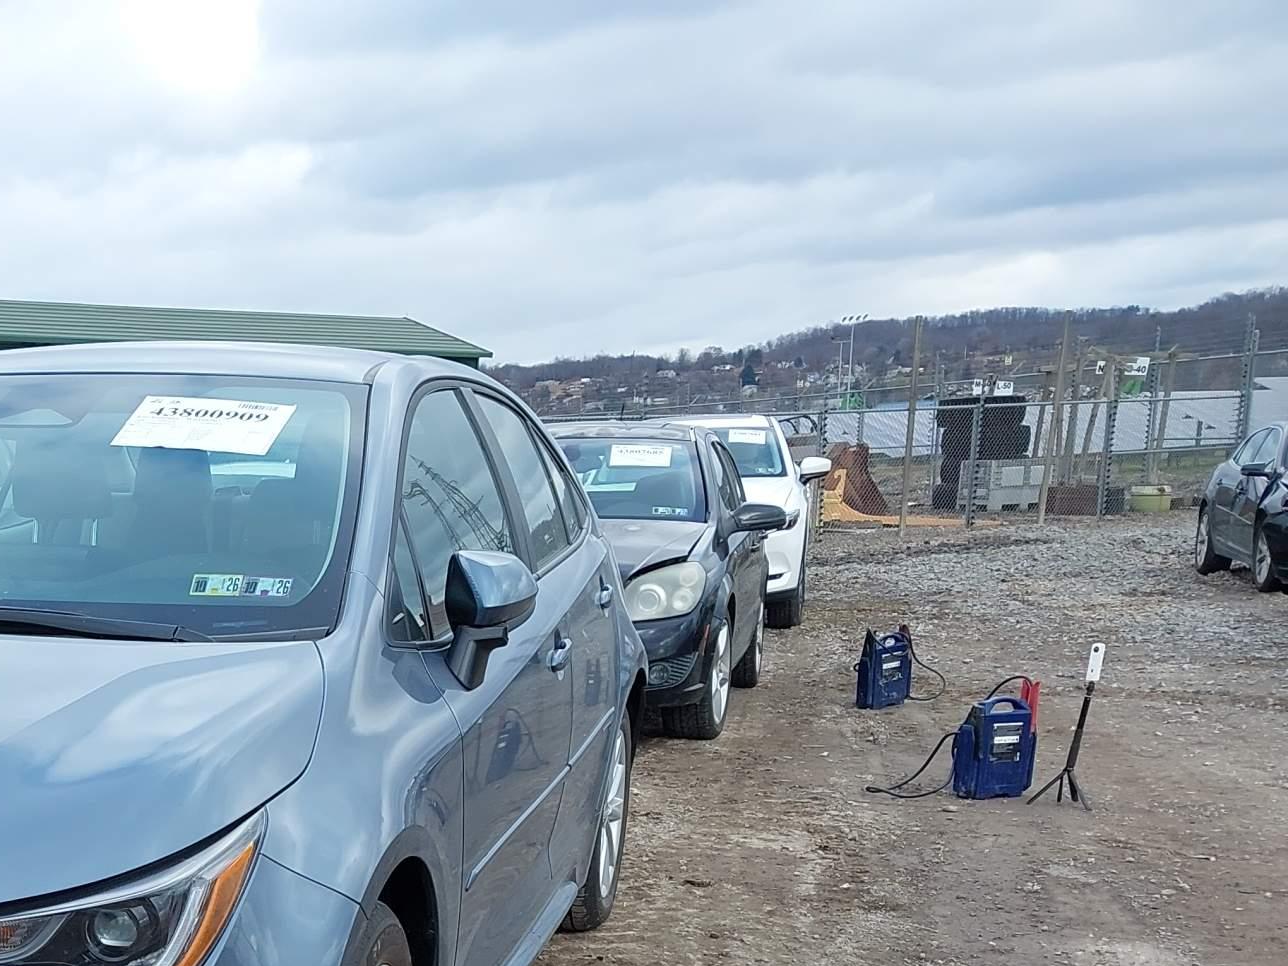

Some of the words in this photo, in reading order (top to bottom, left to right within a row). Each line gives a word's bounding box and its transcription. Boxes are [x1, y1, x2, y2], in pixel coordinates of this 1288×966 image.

[1128, 365, 1147, 374] -40
[149, 406, 270, 423] 43800909
[194, 580, 207, 593] 10
[226, 577, 240, 592] 26
[276, 580, 291, 594] 26
